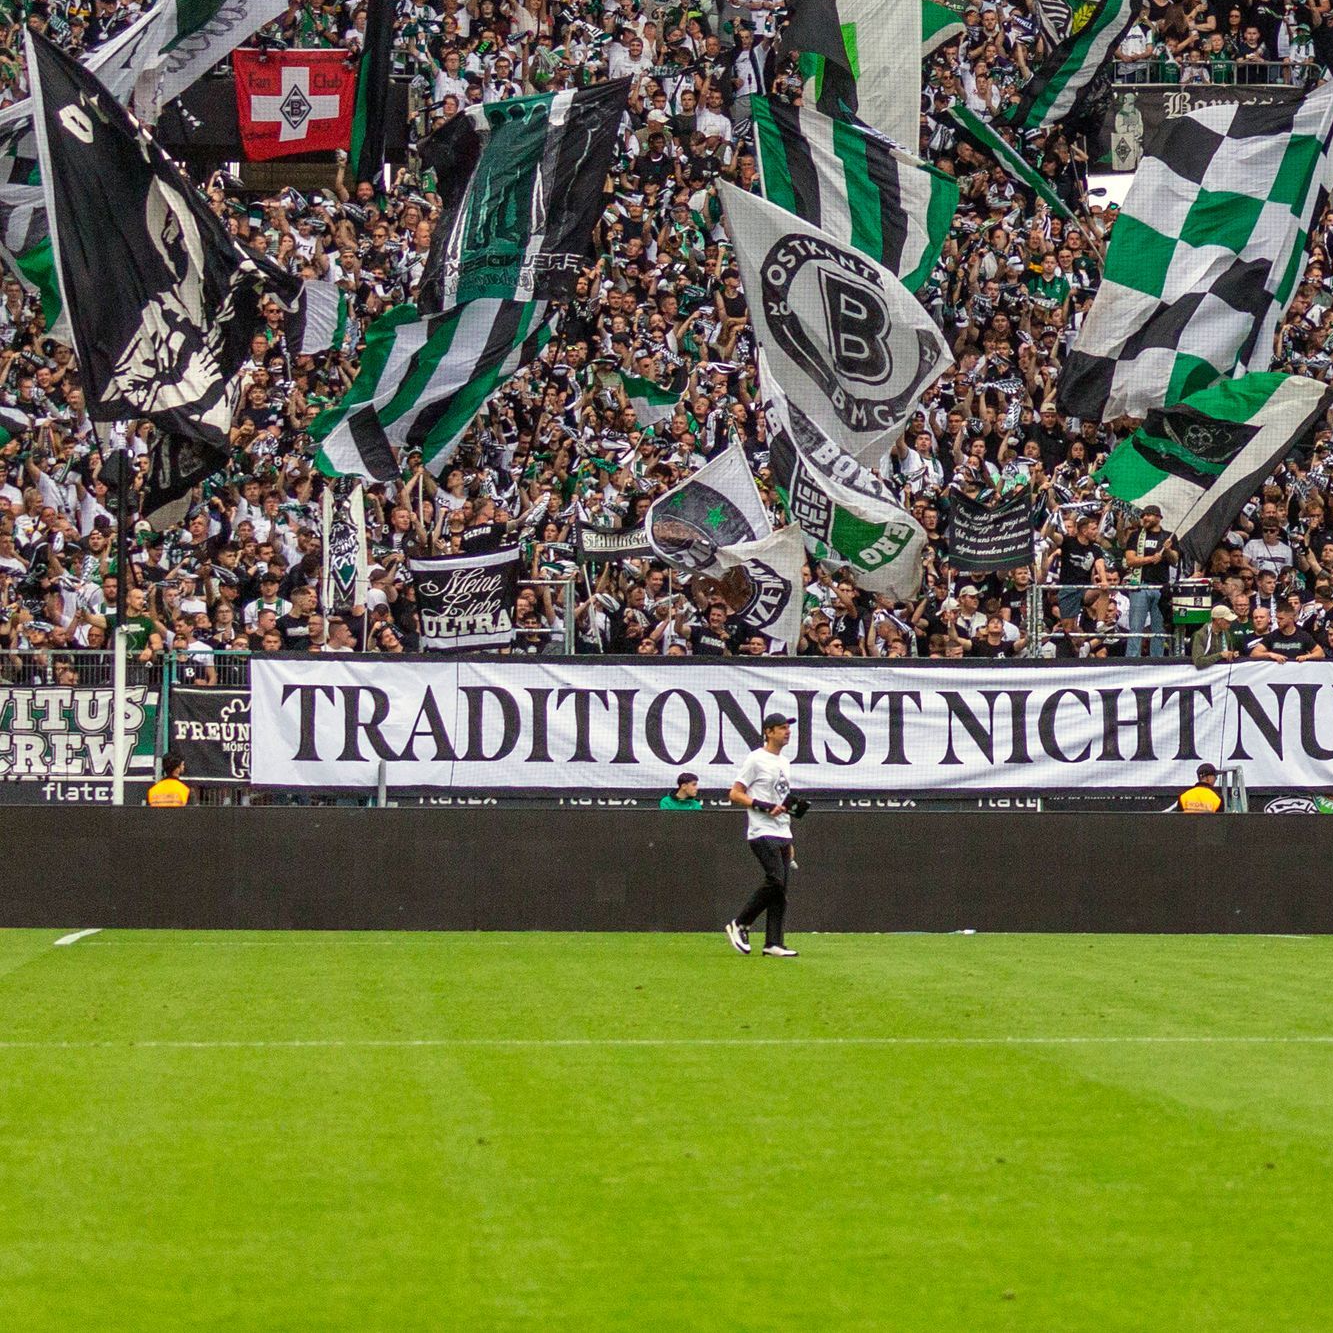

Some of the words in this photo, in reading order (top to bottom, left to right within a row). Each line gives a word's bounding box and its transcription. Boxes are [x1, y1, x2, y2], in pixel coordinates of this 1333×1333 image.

[818, 265, 894, 387] B
[420, 567, 503, 597] Meine
[422, 590, 504, 618] Liebe
[421, 608, 513, 638] ULTRA
[282, 683, 775, 764] TRADITION
[789, 689, 924, 766] IST
[937, 685, 1213, 765] NICHT
